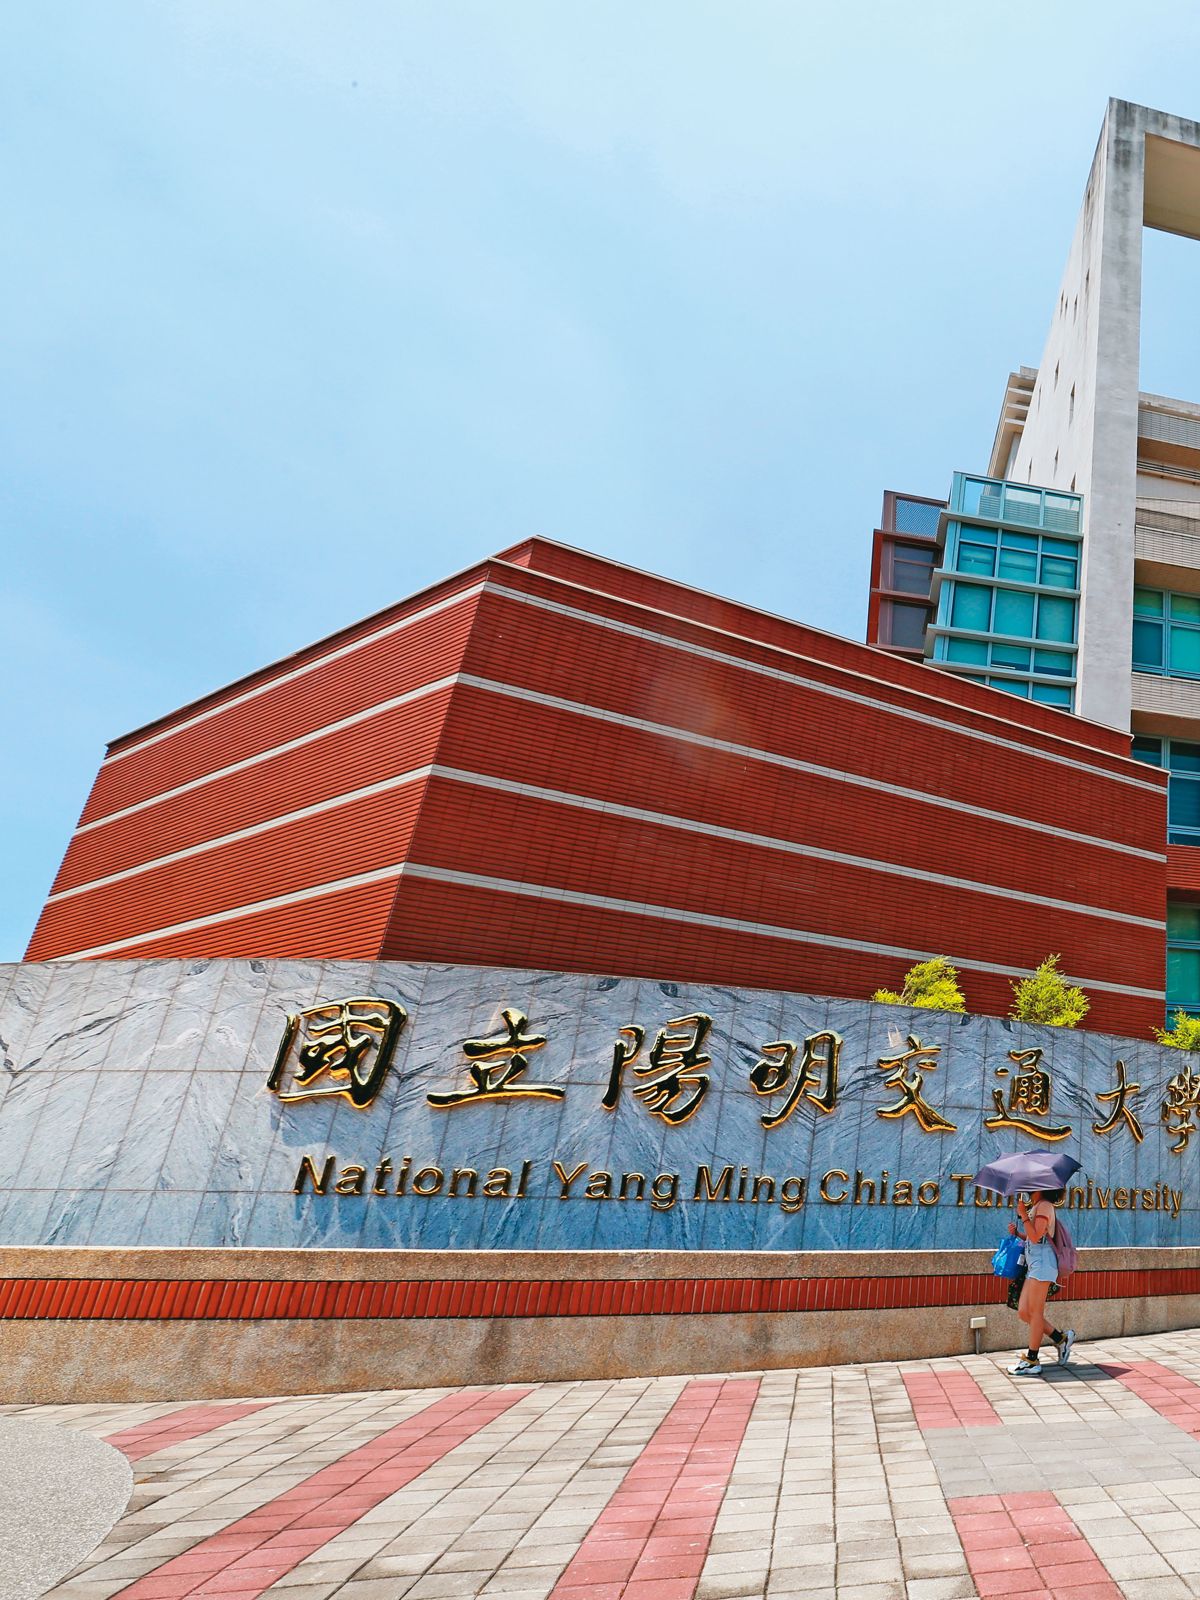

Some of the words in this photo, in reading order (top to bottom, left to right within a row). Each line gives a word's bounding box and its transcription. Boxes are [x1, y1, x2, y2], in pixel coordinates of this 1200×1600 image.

[293, 1154, 532, 1197] National
[552, 1160, 680, 1211] Yang
[693, 1163, 807, 1214] Ming
[820, 1168, 940, 1207] Chiao
